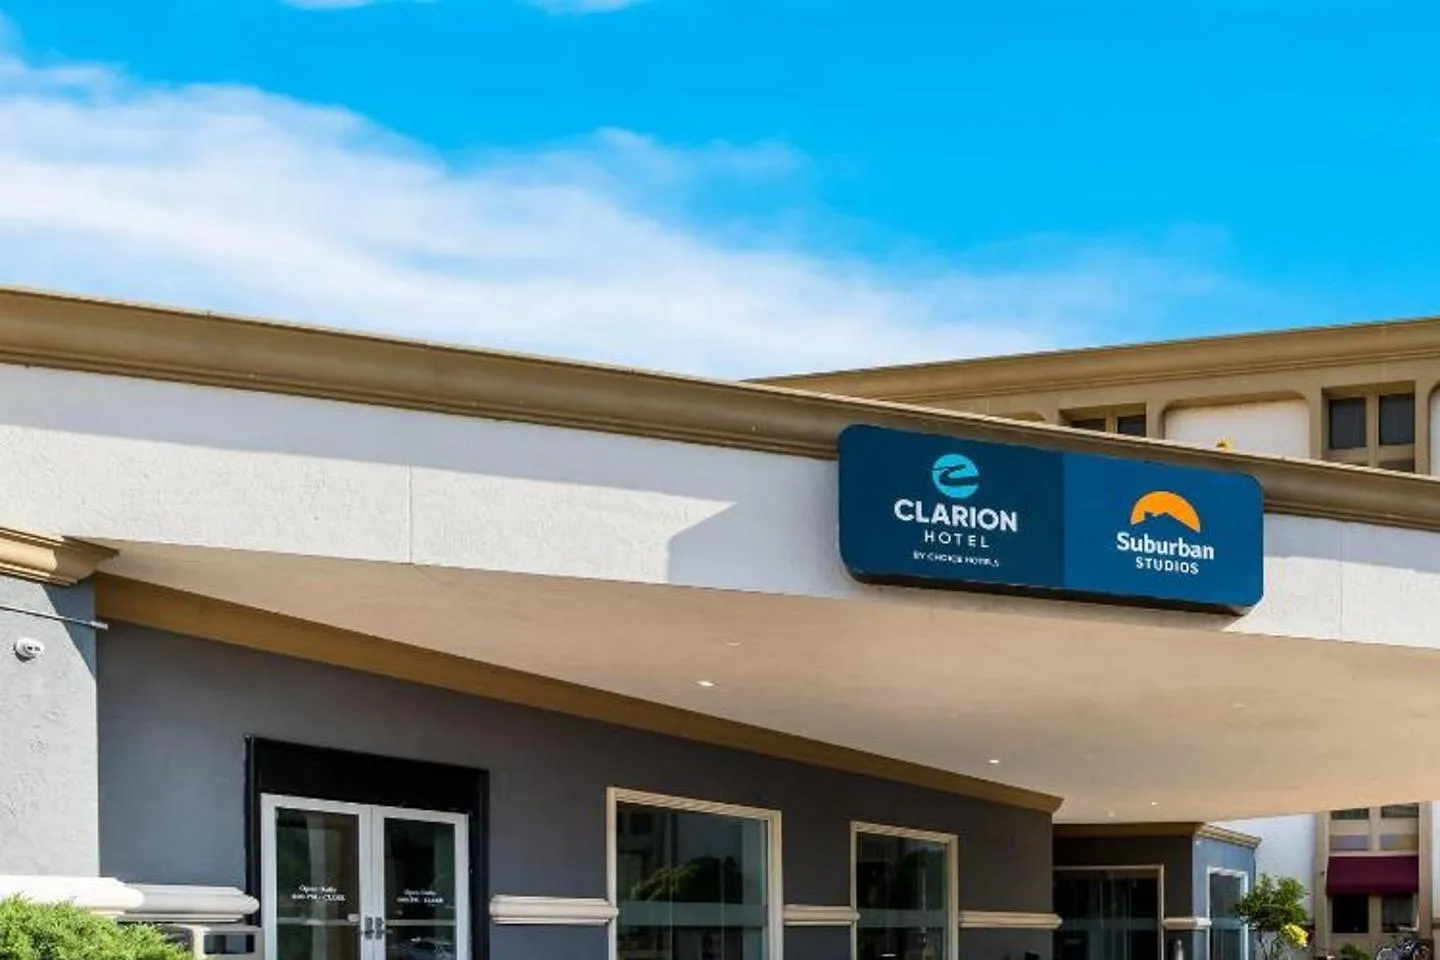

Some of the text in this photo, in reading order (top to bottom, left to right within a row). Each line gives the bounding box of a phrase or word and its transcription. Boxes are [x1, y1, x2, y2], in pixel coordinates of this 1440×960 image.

[894, 498, 1018, 532] CLARION
[924, 530, 990, 548] HOTEL
[1116, 531, 1215, 560] Suburban
[912, 550, 1000, 568] BY CHOICE HOTELS
[1135, 556, 1200, 575] STUDIOS
